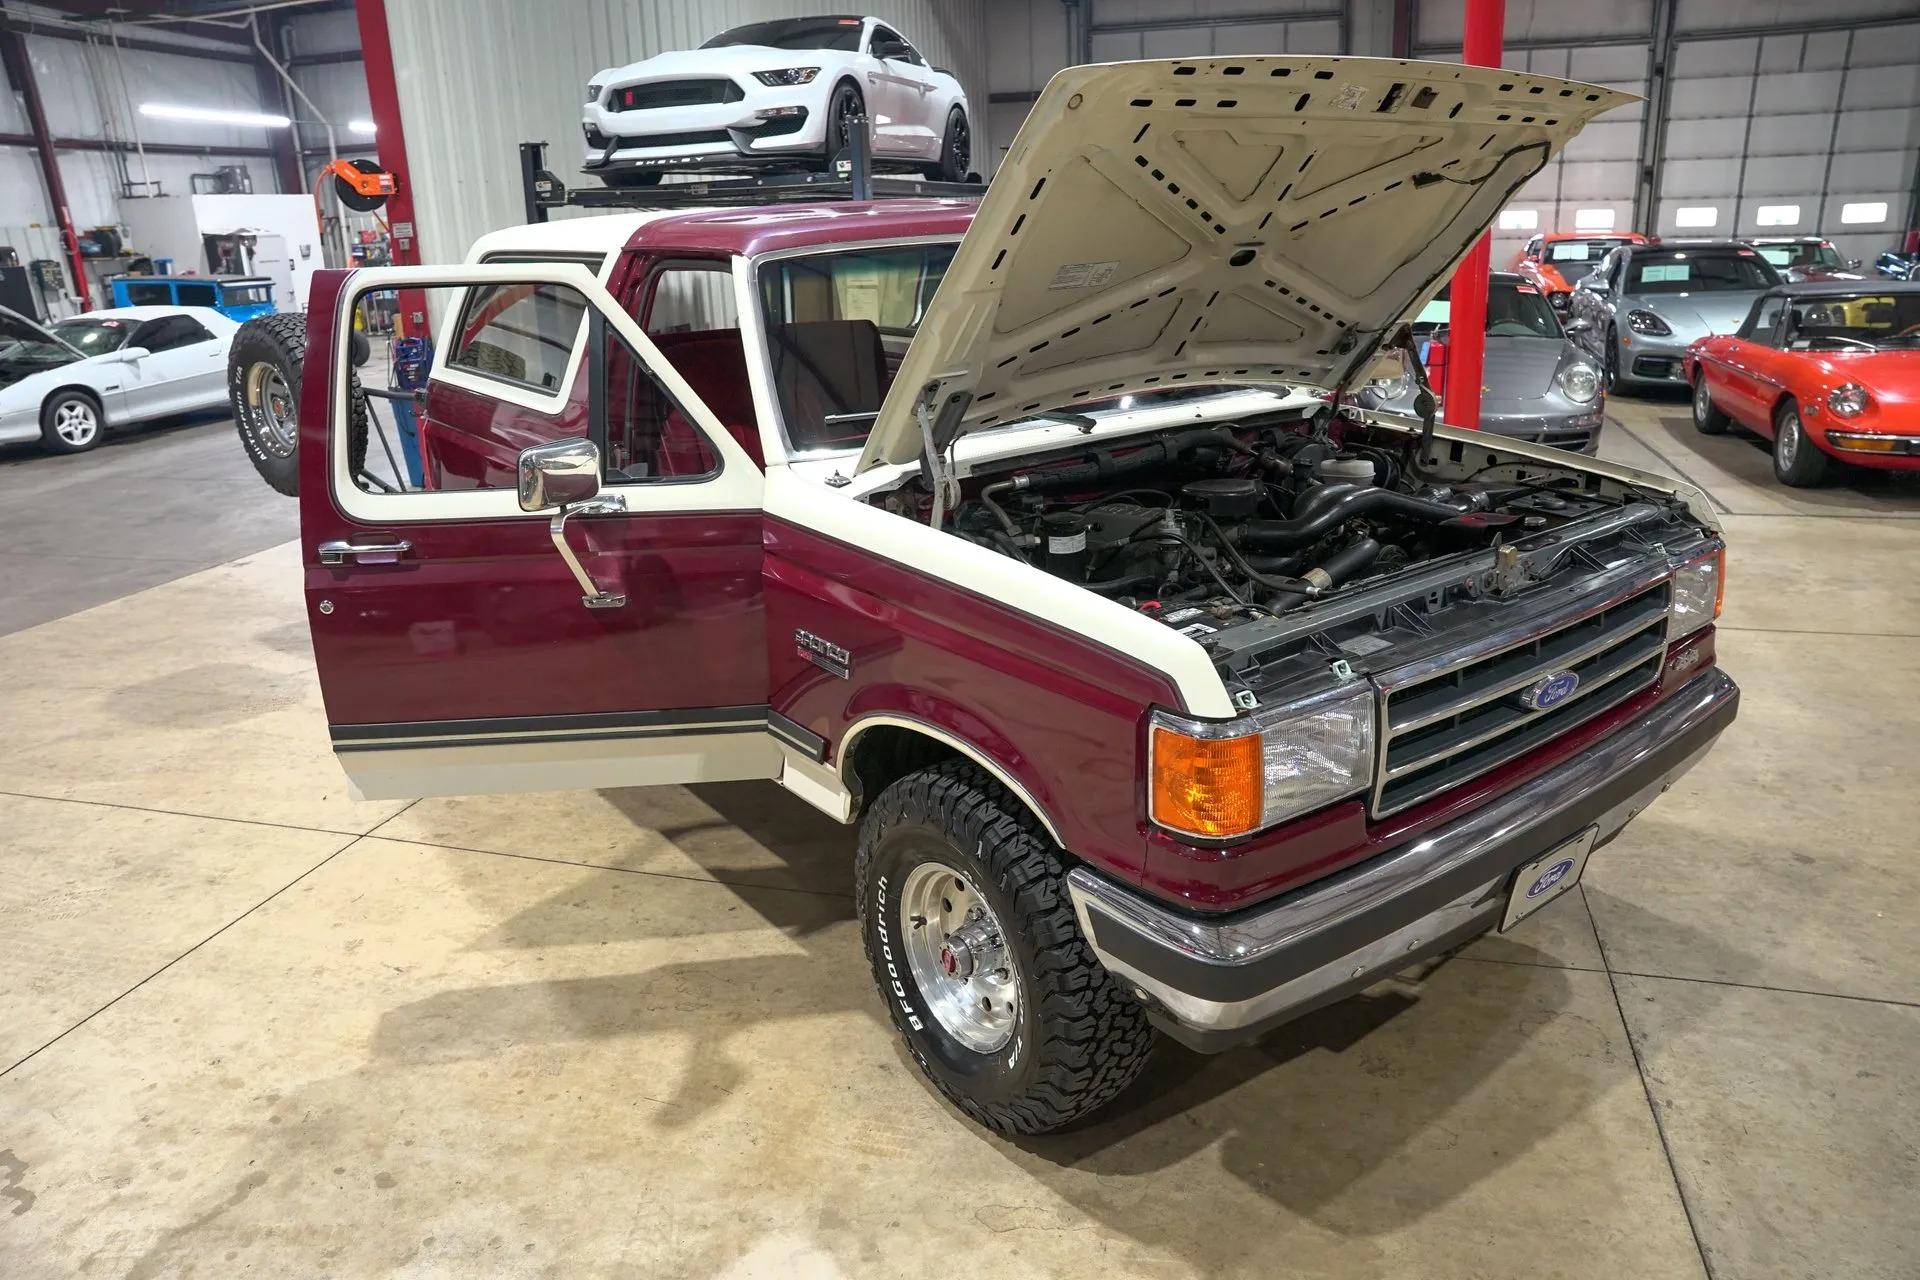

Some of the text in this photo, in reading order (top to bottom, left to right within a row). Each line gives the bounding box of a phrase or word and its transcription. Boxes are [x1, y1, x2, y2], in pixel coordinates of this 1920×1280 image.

[1544, 680, 1570, 704] Ford
[1533, 865, 1566, 894] Ford
[877, 875, 924, 1032] BFGoodrich
